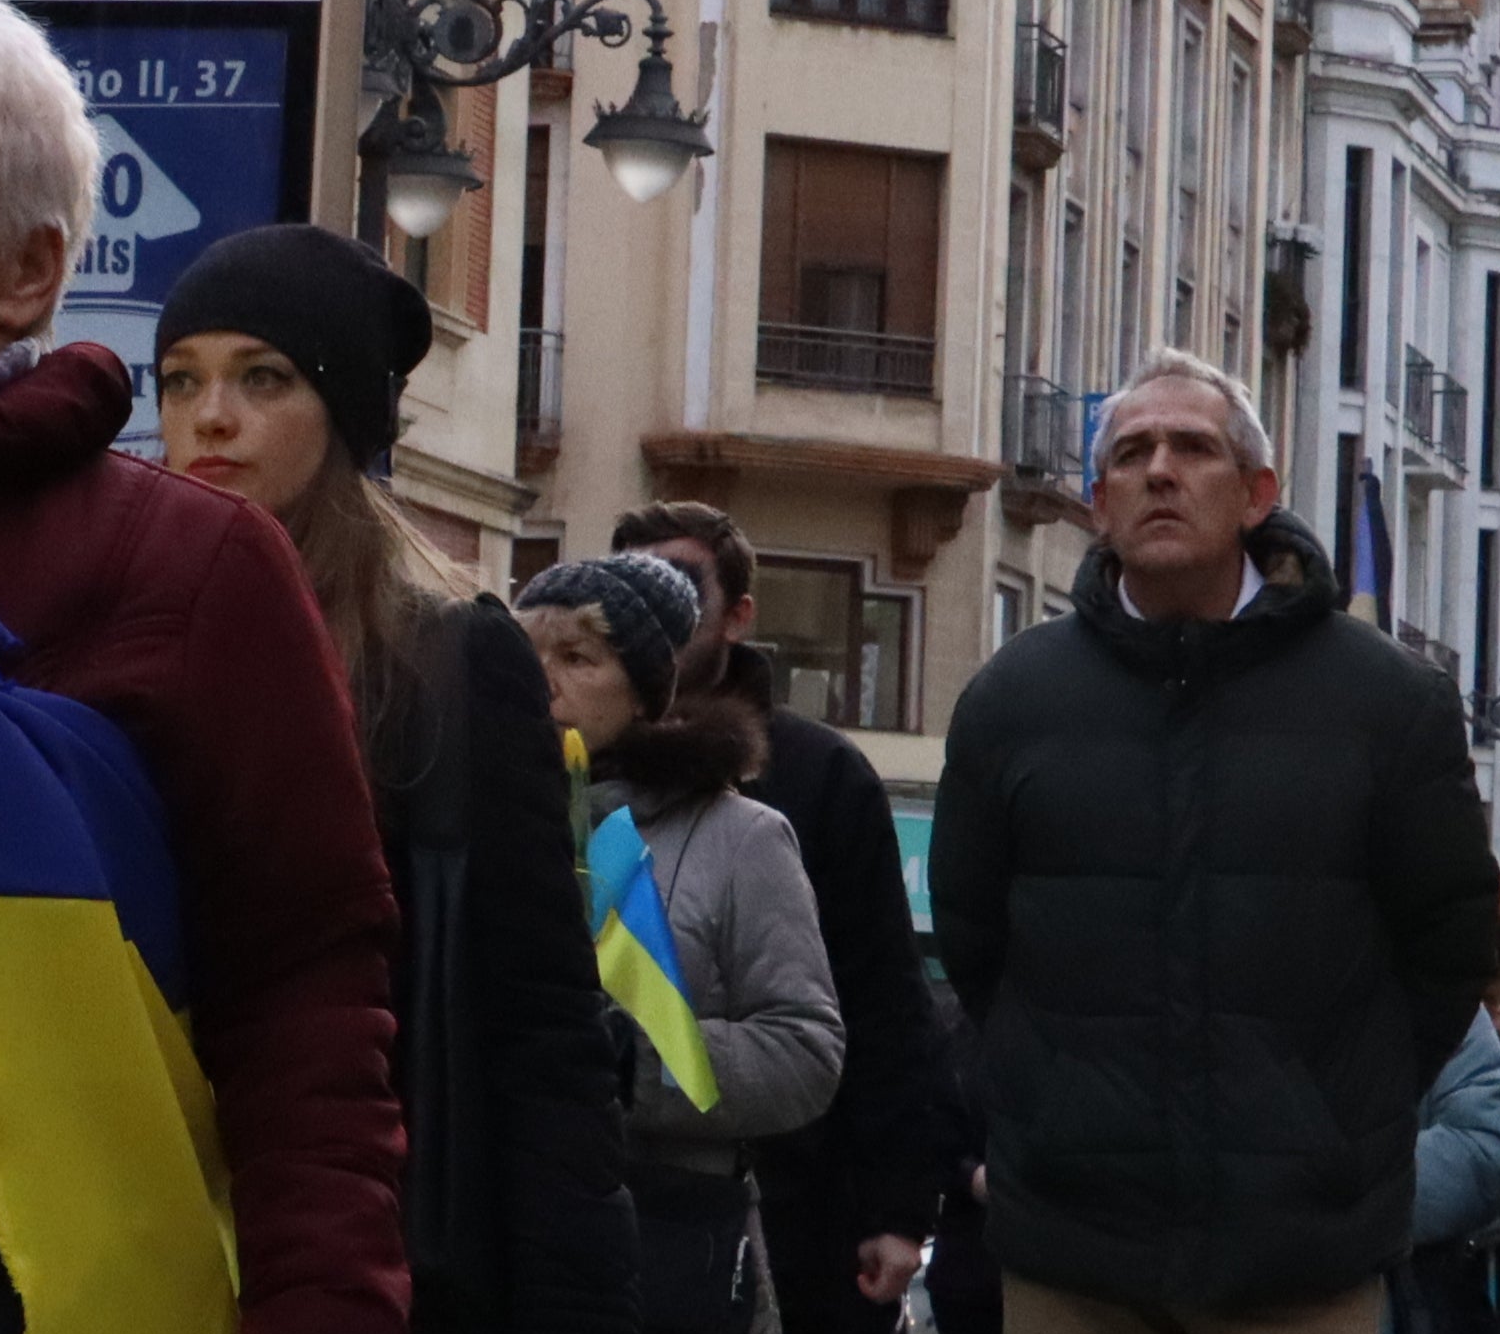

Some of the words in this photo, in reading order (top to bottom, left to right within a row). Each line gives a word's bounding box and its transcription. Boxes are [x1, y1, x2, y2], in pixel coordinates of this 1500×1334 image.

[76, 60, 122, 98] ño
[195, 60, 246, 98] 37
[103, 153, 143, 218] 0
